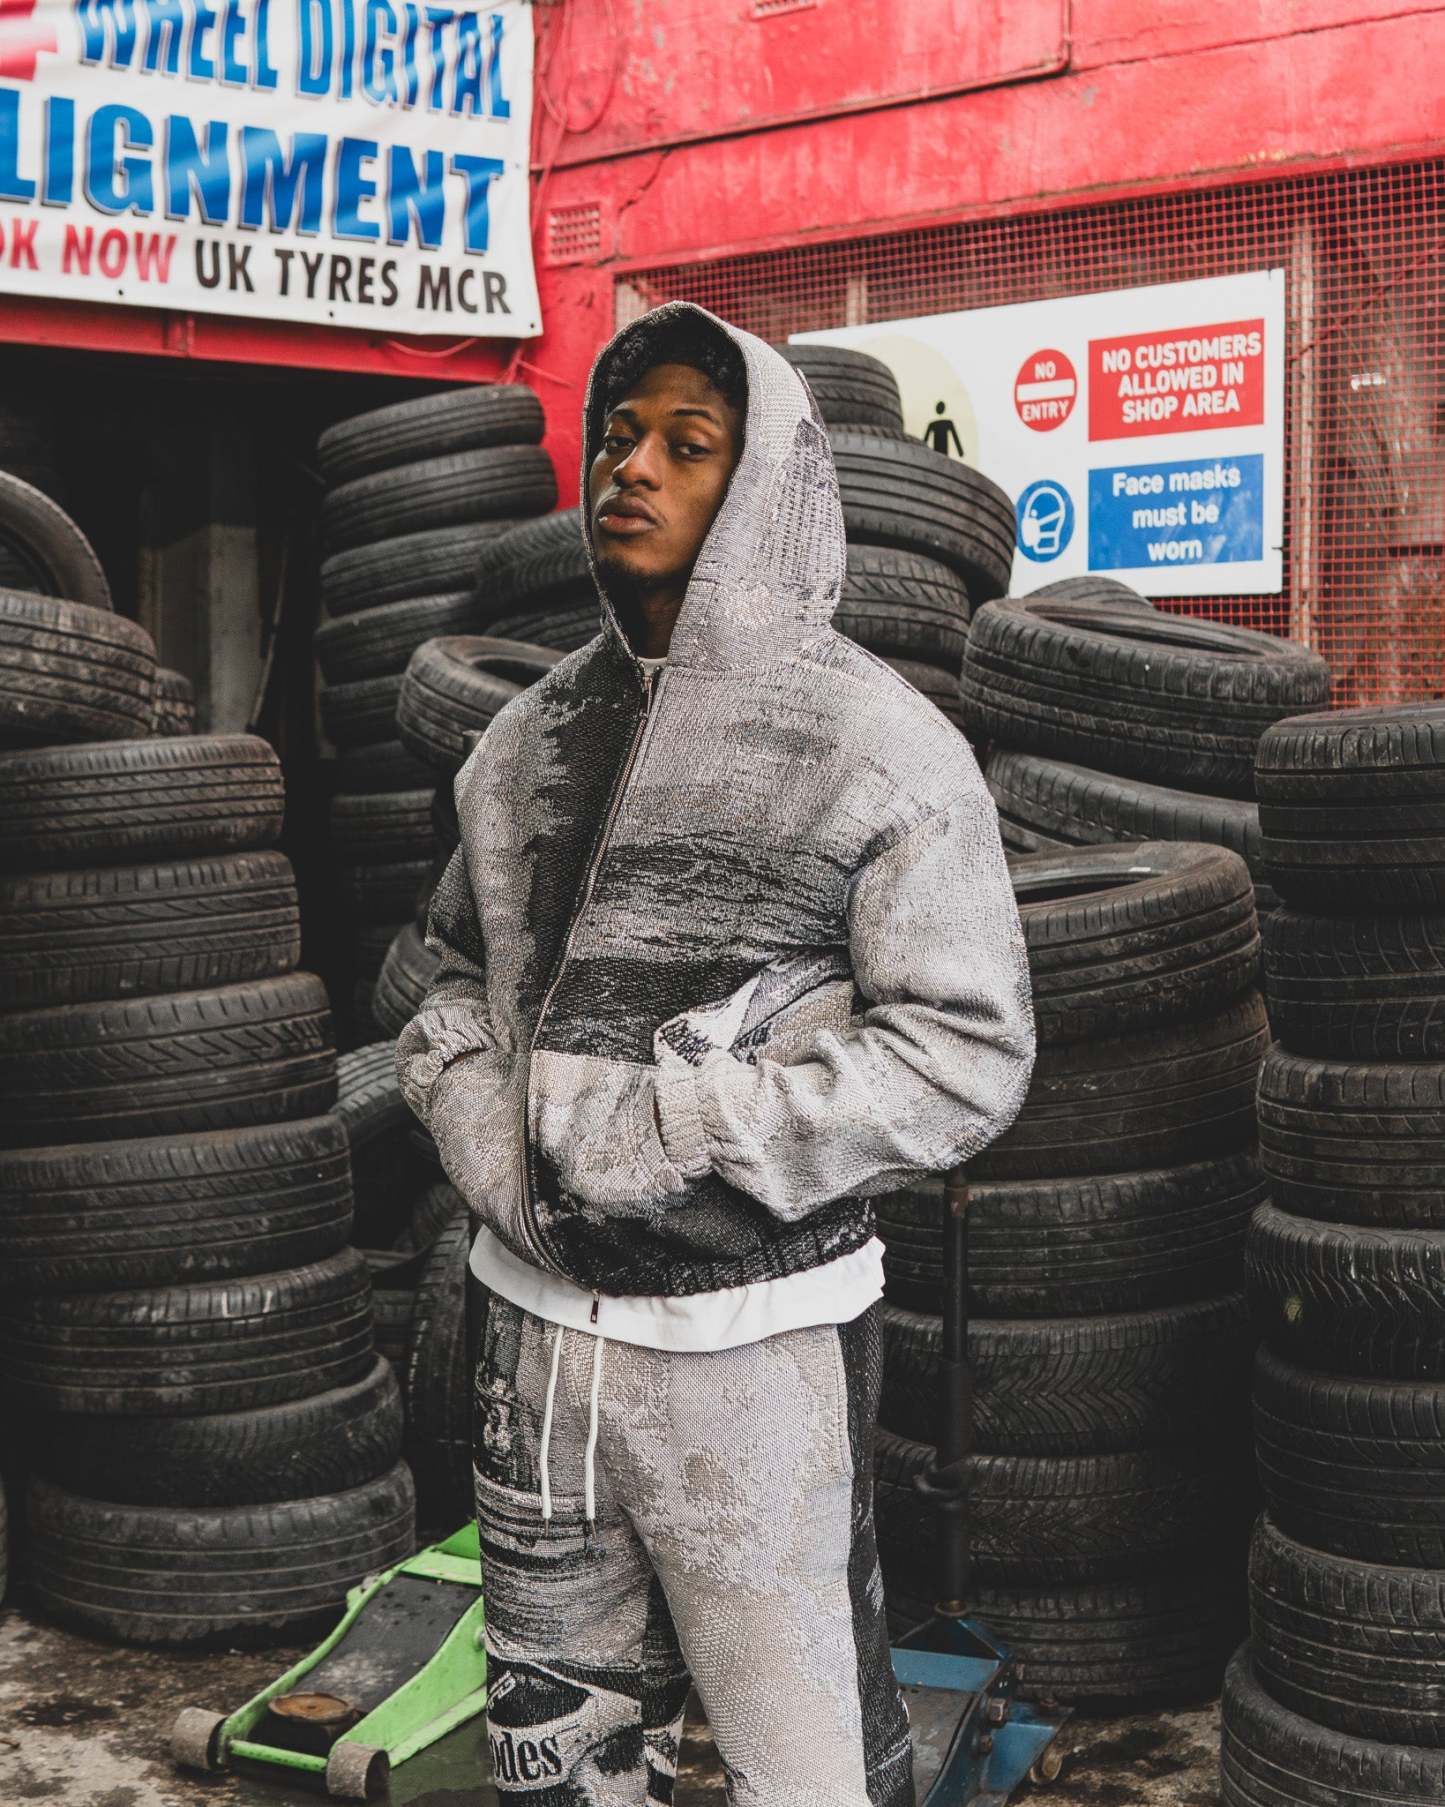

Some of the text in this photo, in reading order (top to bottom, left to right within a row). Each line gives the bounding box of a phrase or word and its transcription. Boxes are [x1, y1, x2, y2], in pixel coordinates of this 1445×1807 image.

[75, 0, 278, 91] WHEEL
[296, 0, 512, 120] DIGITAL
[0, 218, 511, 315] K NOW UK TYRES MCR
[1102, 332, 1262, 374] NO CUSTOMERS
[1034, 361, 1056, 380] NO
[1118, 361, 1244, 398] ALLOWED IN
[1022, 400, 1069, 423] ENTRY
[1122, 389, 1240, 424] SHOP AREA
[1112, 464, 1241, 497] Face masks
[1132, 500, 1219, 529] must be
[1148, 538, 1202, 562] worn
